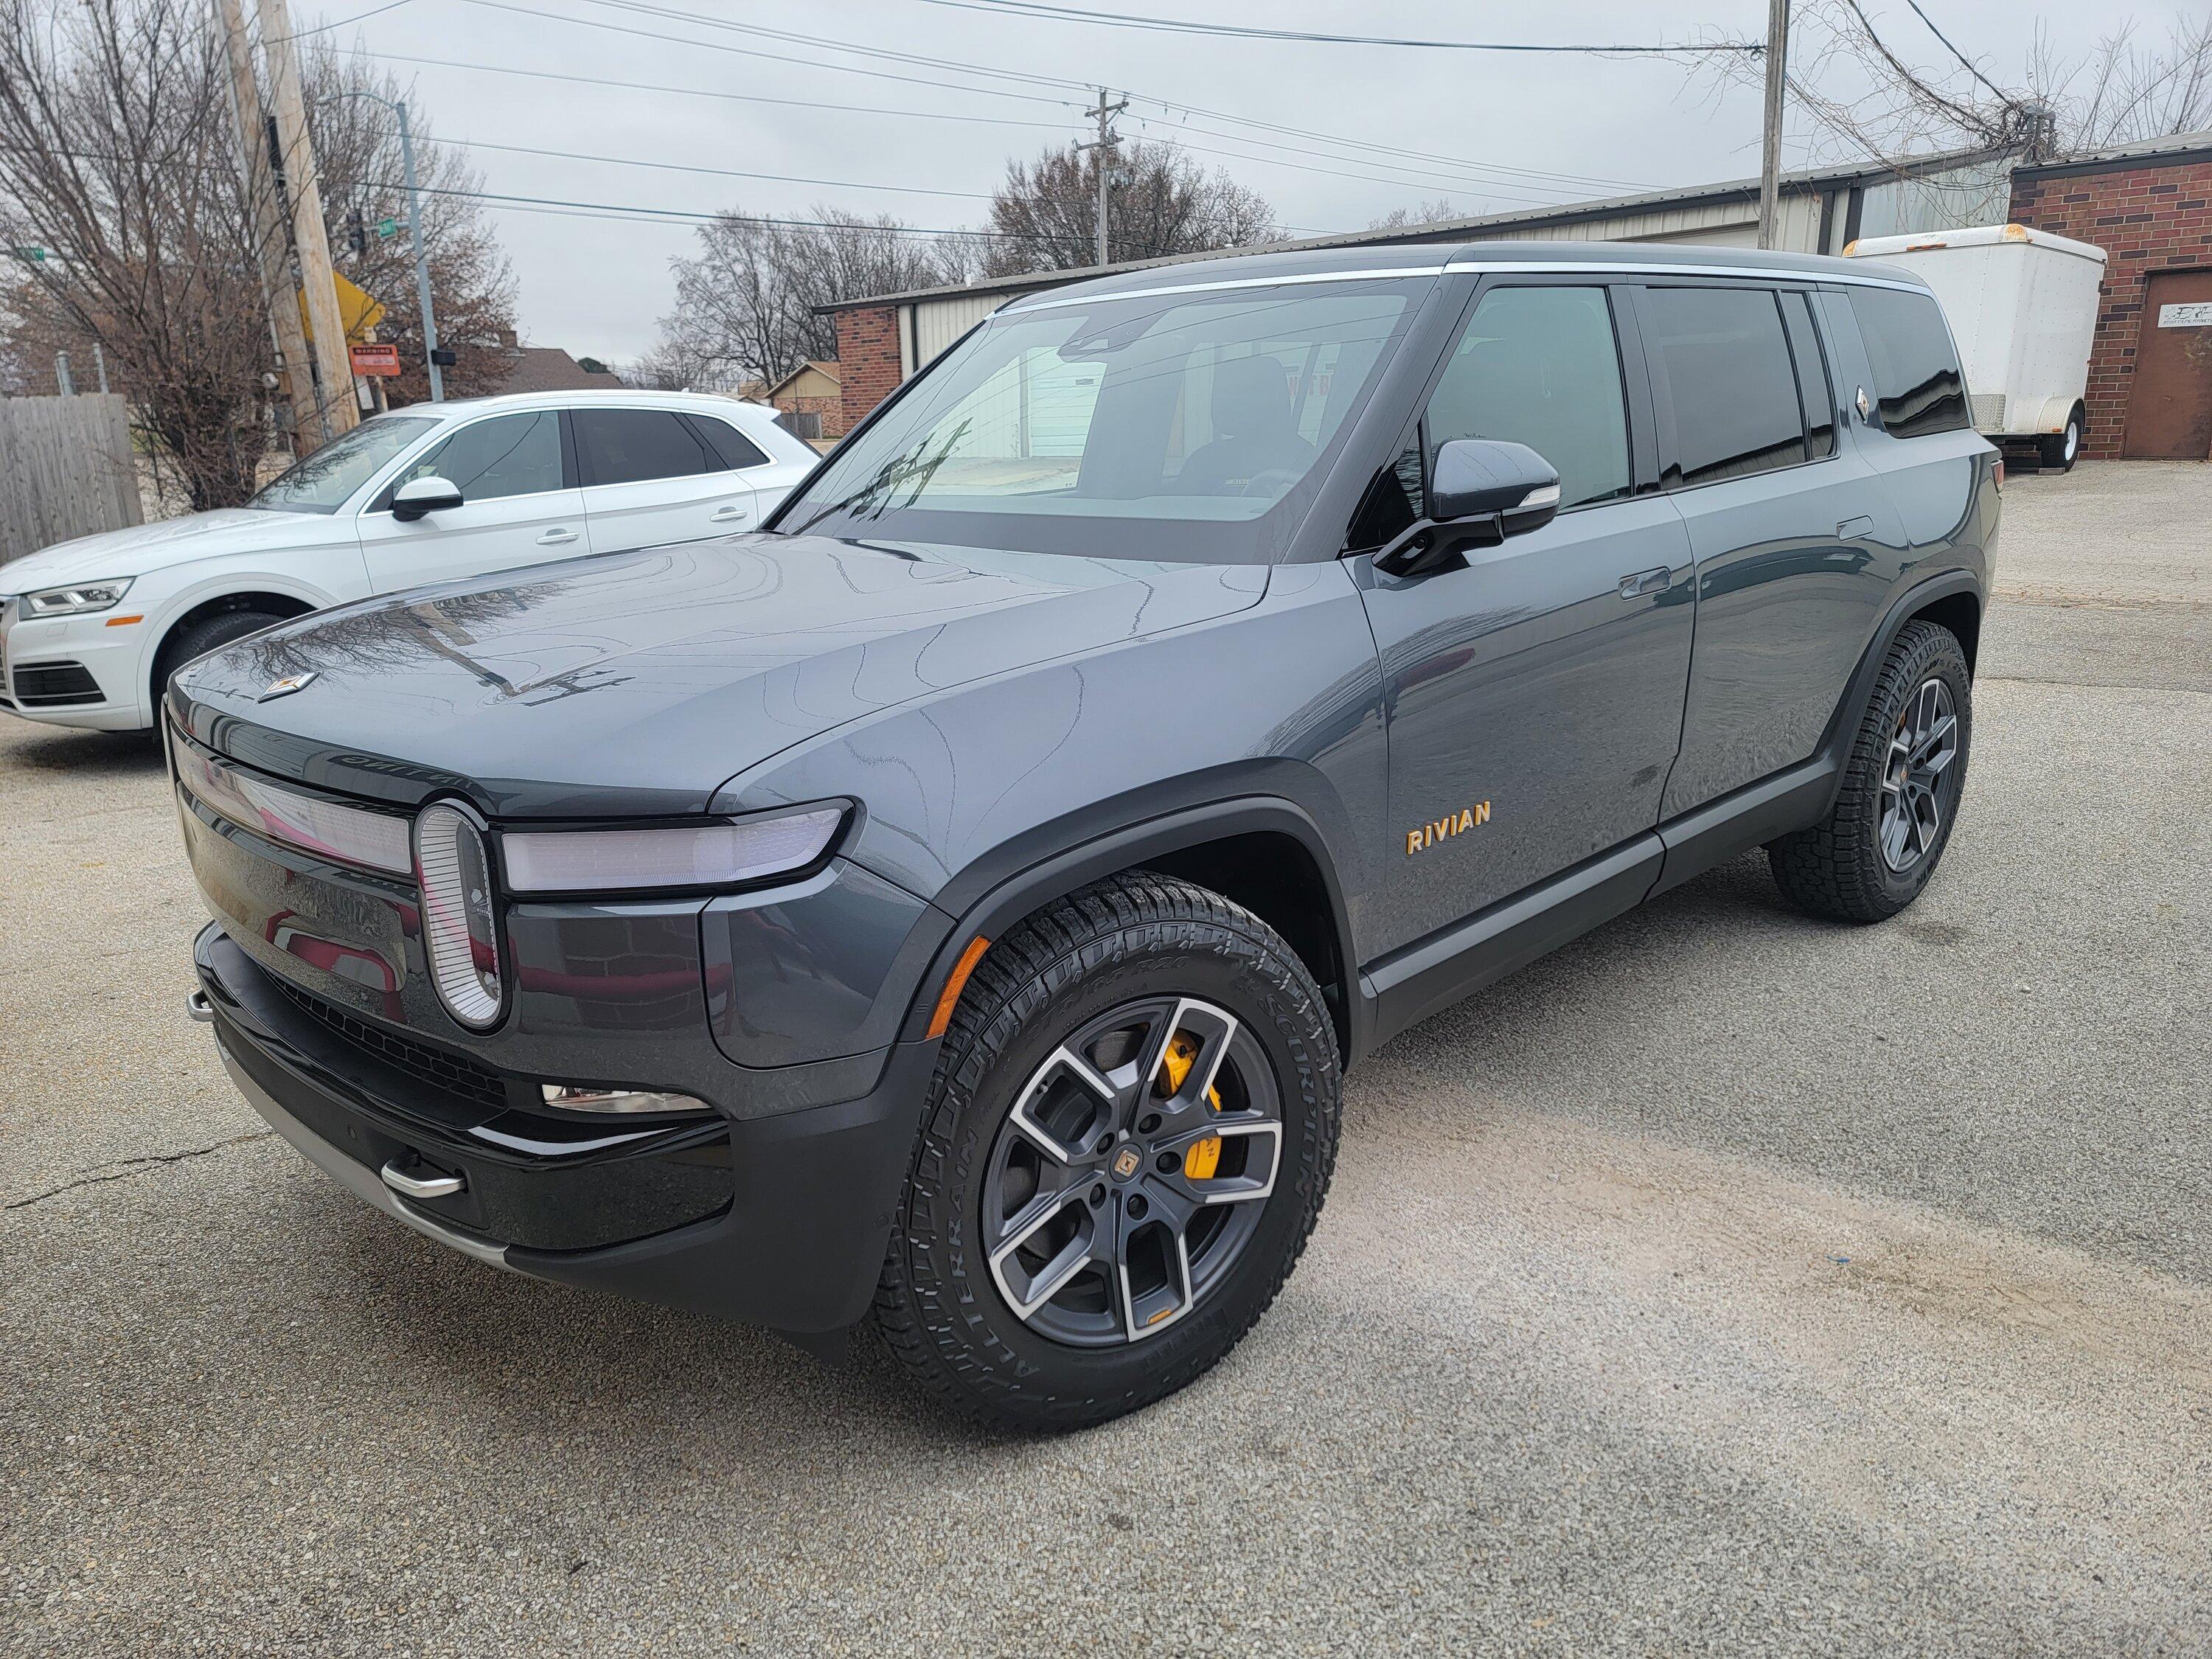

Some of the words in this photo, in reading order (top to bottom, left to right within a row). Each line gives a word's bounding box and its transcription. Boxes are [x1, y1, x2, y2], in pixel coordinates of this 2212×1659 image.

[1408, 801, 1491, 855] RIVIAN
[1257, 994, 1318, 1198] SCORPION
[947, 1127, 1041, 1379] ALLTERRAIN
